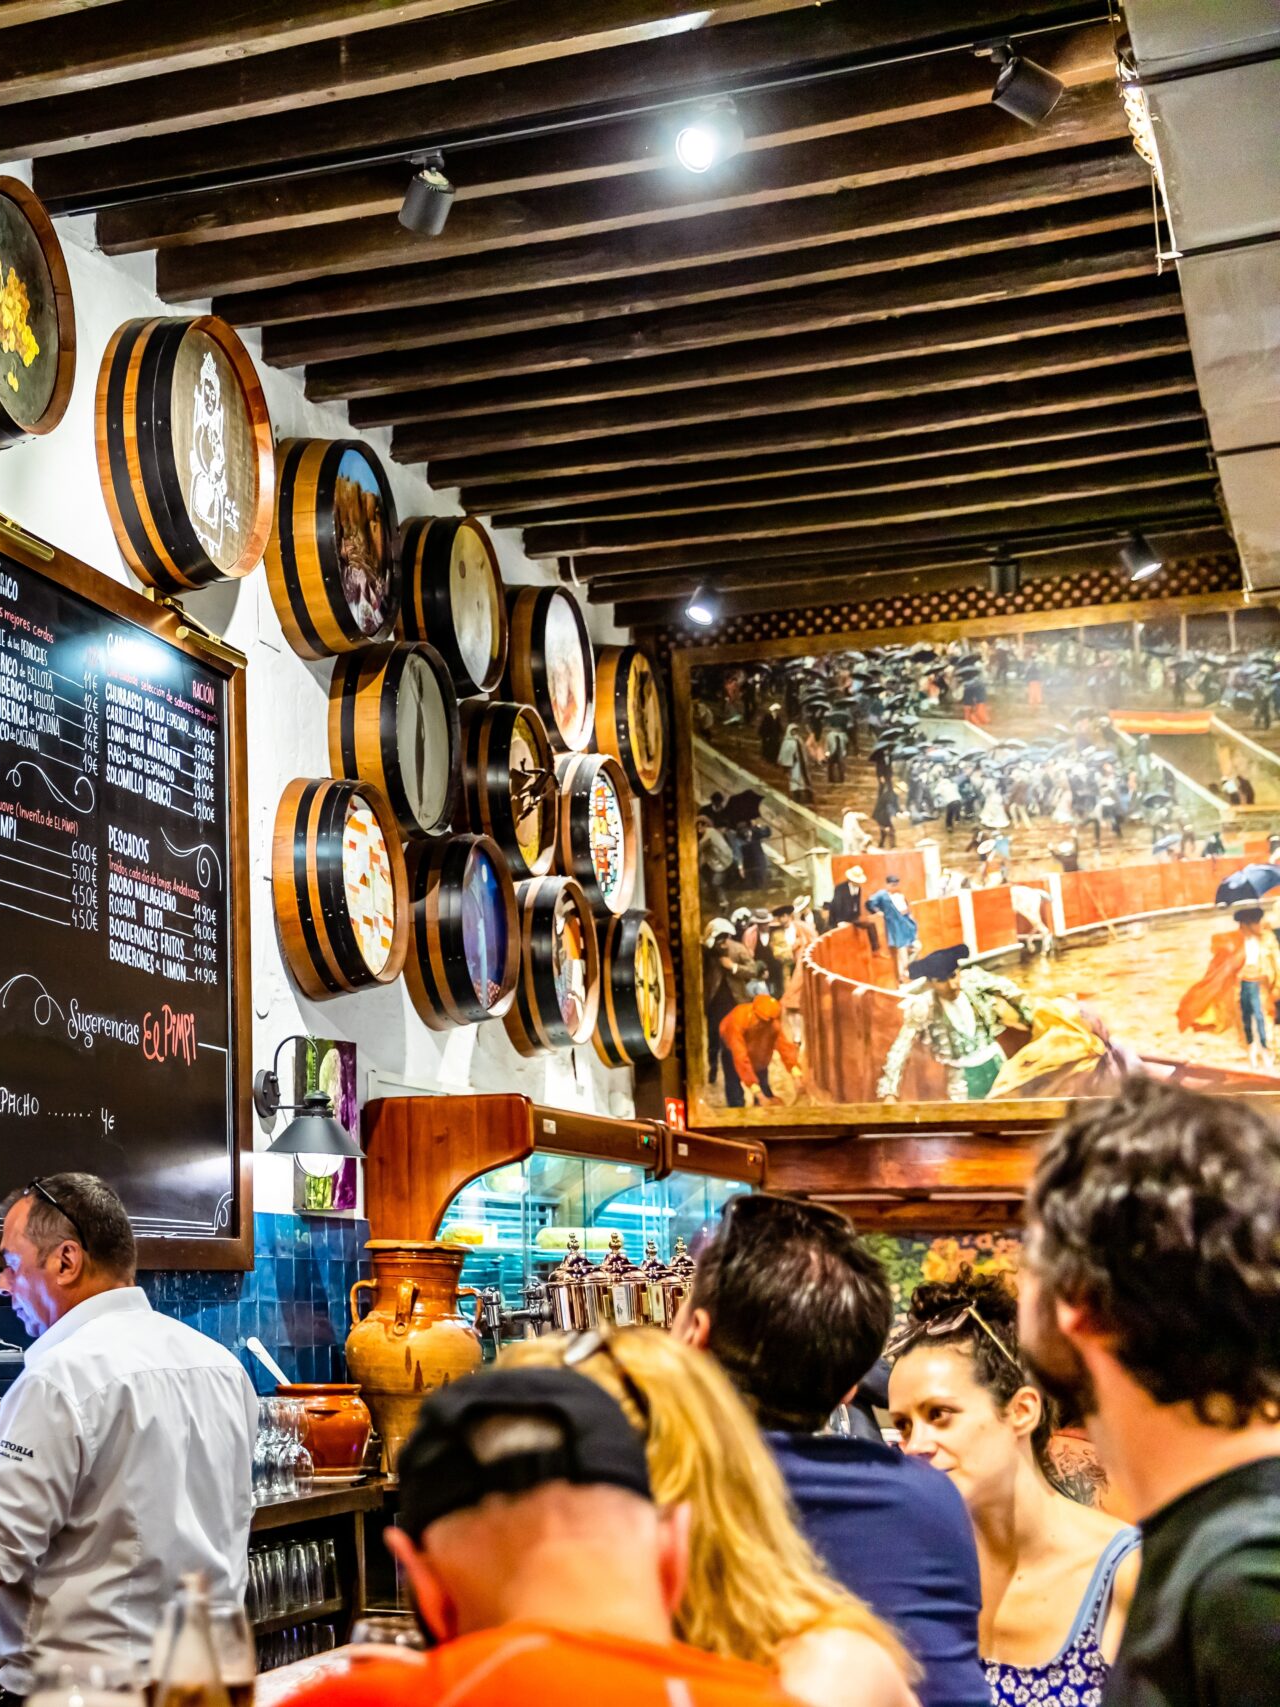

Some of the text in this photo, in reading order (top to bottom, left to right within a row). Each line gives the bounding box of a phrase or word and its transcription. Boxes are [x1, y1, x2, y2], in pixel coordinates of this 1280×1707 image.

[5, 610, 30, 630] mejores
[33, 623, 54, 644] cerdos
[27, 666, 53, 692] BELLOTA
[84, 692, 98, 714] 12€
[34, 690, 56, 714] BELLOTA
[106, 682, 165, 722] CHURRASCO POLLO
[192, 680, 215, 706] RACIÓN
[106, 704, 168, 744] CARRILLADA VACA
[83, 753, 98, 776] 19€
[107, 723, 181, 770] LOMO VACA MADURADA
[107, 744, 126, 765] RABO
[106, 764, 171, 808] SOLOMILLO IBÉRICO
[108, 825, 149, 864] PESCADOS
[108, 873, 176, 912] ADOBO MALAGUEÑO
[108, 894, 163, 929] ROSADA FRITA
[109, 916, 185, 960] BOQUERONES FRITOS
[110, 939, 186, 982] BOQUERONES LIMÓN
[68, 998, 139, 1049] Sugerencias
